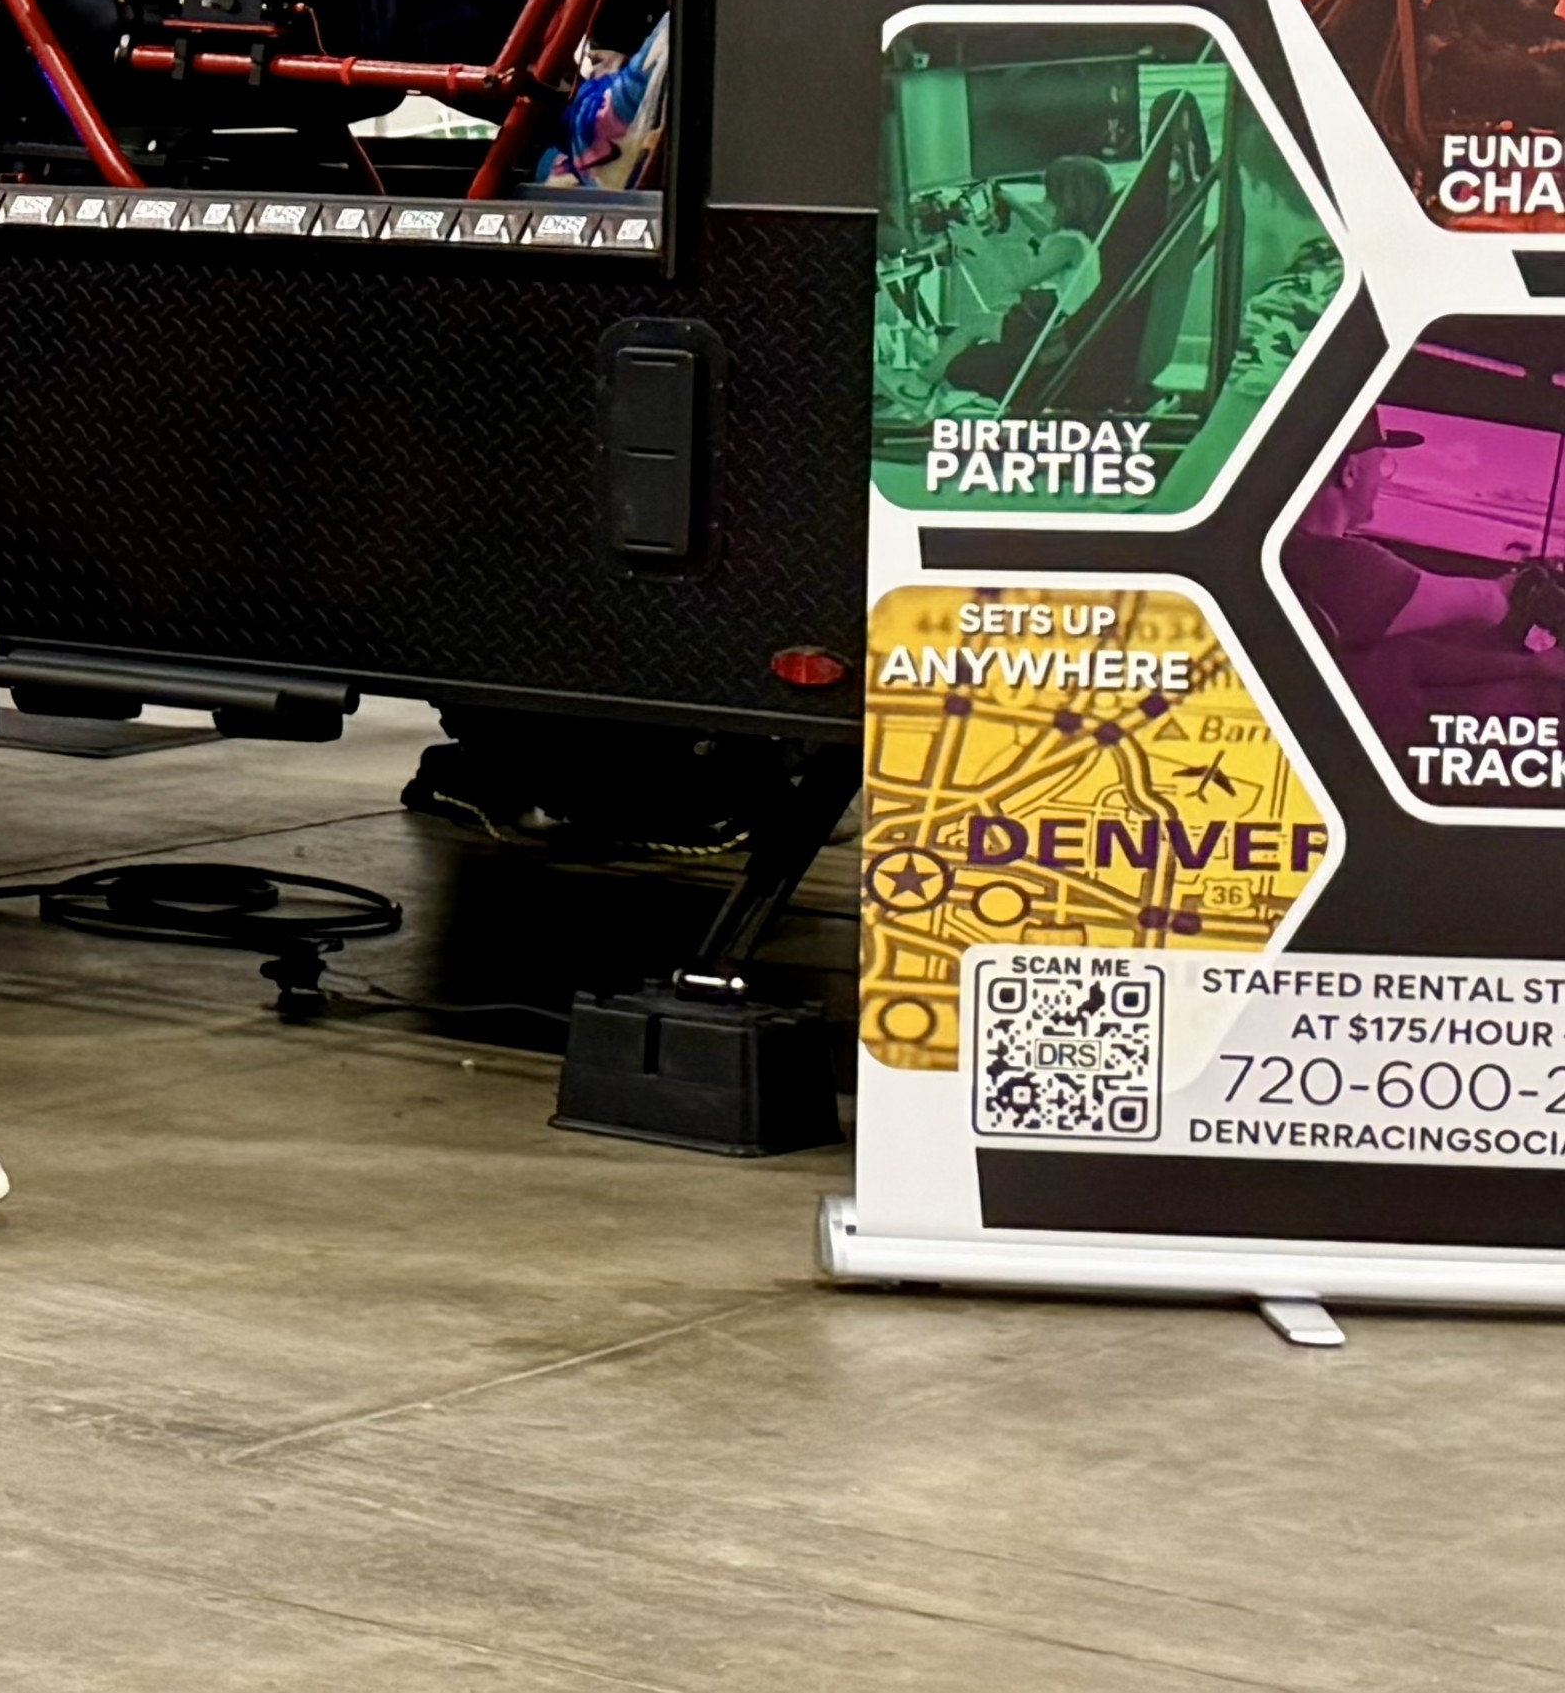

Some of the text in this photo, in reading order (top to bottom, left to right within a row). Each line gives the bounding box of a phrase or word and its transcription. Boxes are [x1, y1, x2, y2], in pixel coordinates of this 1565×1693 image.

[1443, 134, 1564, 168] FUND
[1439, 170, 1565, 214] CHA
[400, 212, 439, 227] DRS
[541, 216, 581, 231] DRS
[932, 418, 1151, 453] BIRTHDAY
[926, 452, 1157, 496] PARTIES
[958, 603, 1053, 635] SETS
[1062, 604, 1117, 636] UP
[878, 646, 1191, 690] ANYWHERE
[1429, 714, 1559, 747] TRADE
[1211, 885, 1245, 905] 36
[1011, 956, 1131, 977] SCAN ME
[1202, 968, 1362, 998] STAFFED
[1373, 973, 1515, 1004] RENTAL
[1291, 1012, 1554, 1048] AT $175/HOUR
[1038, 1043, 1098, 1068] DRS
[1219, 1054, 1565, 1114] 720-600-2
